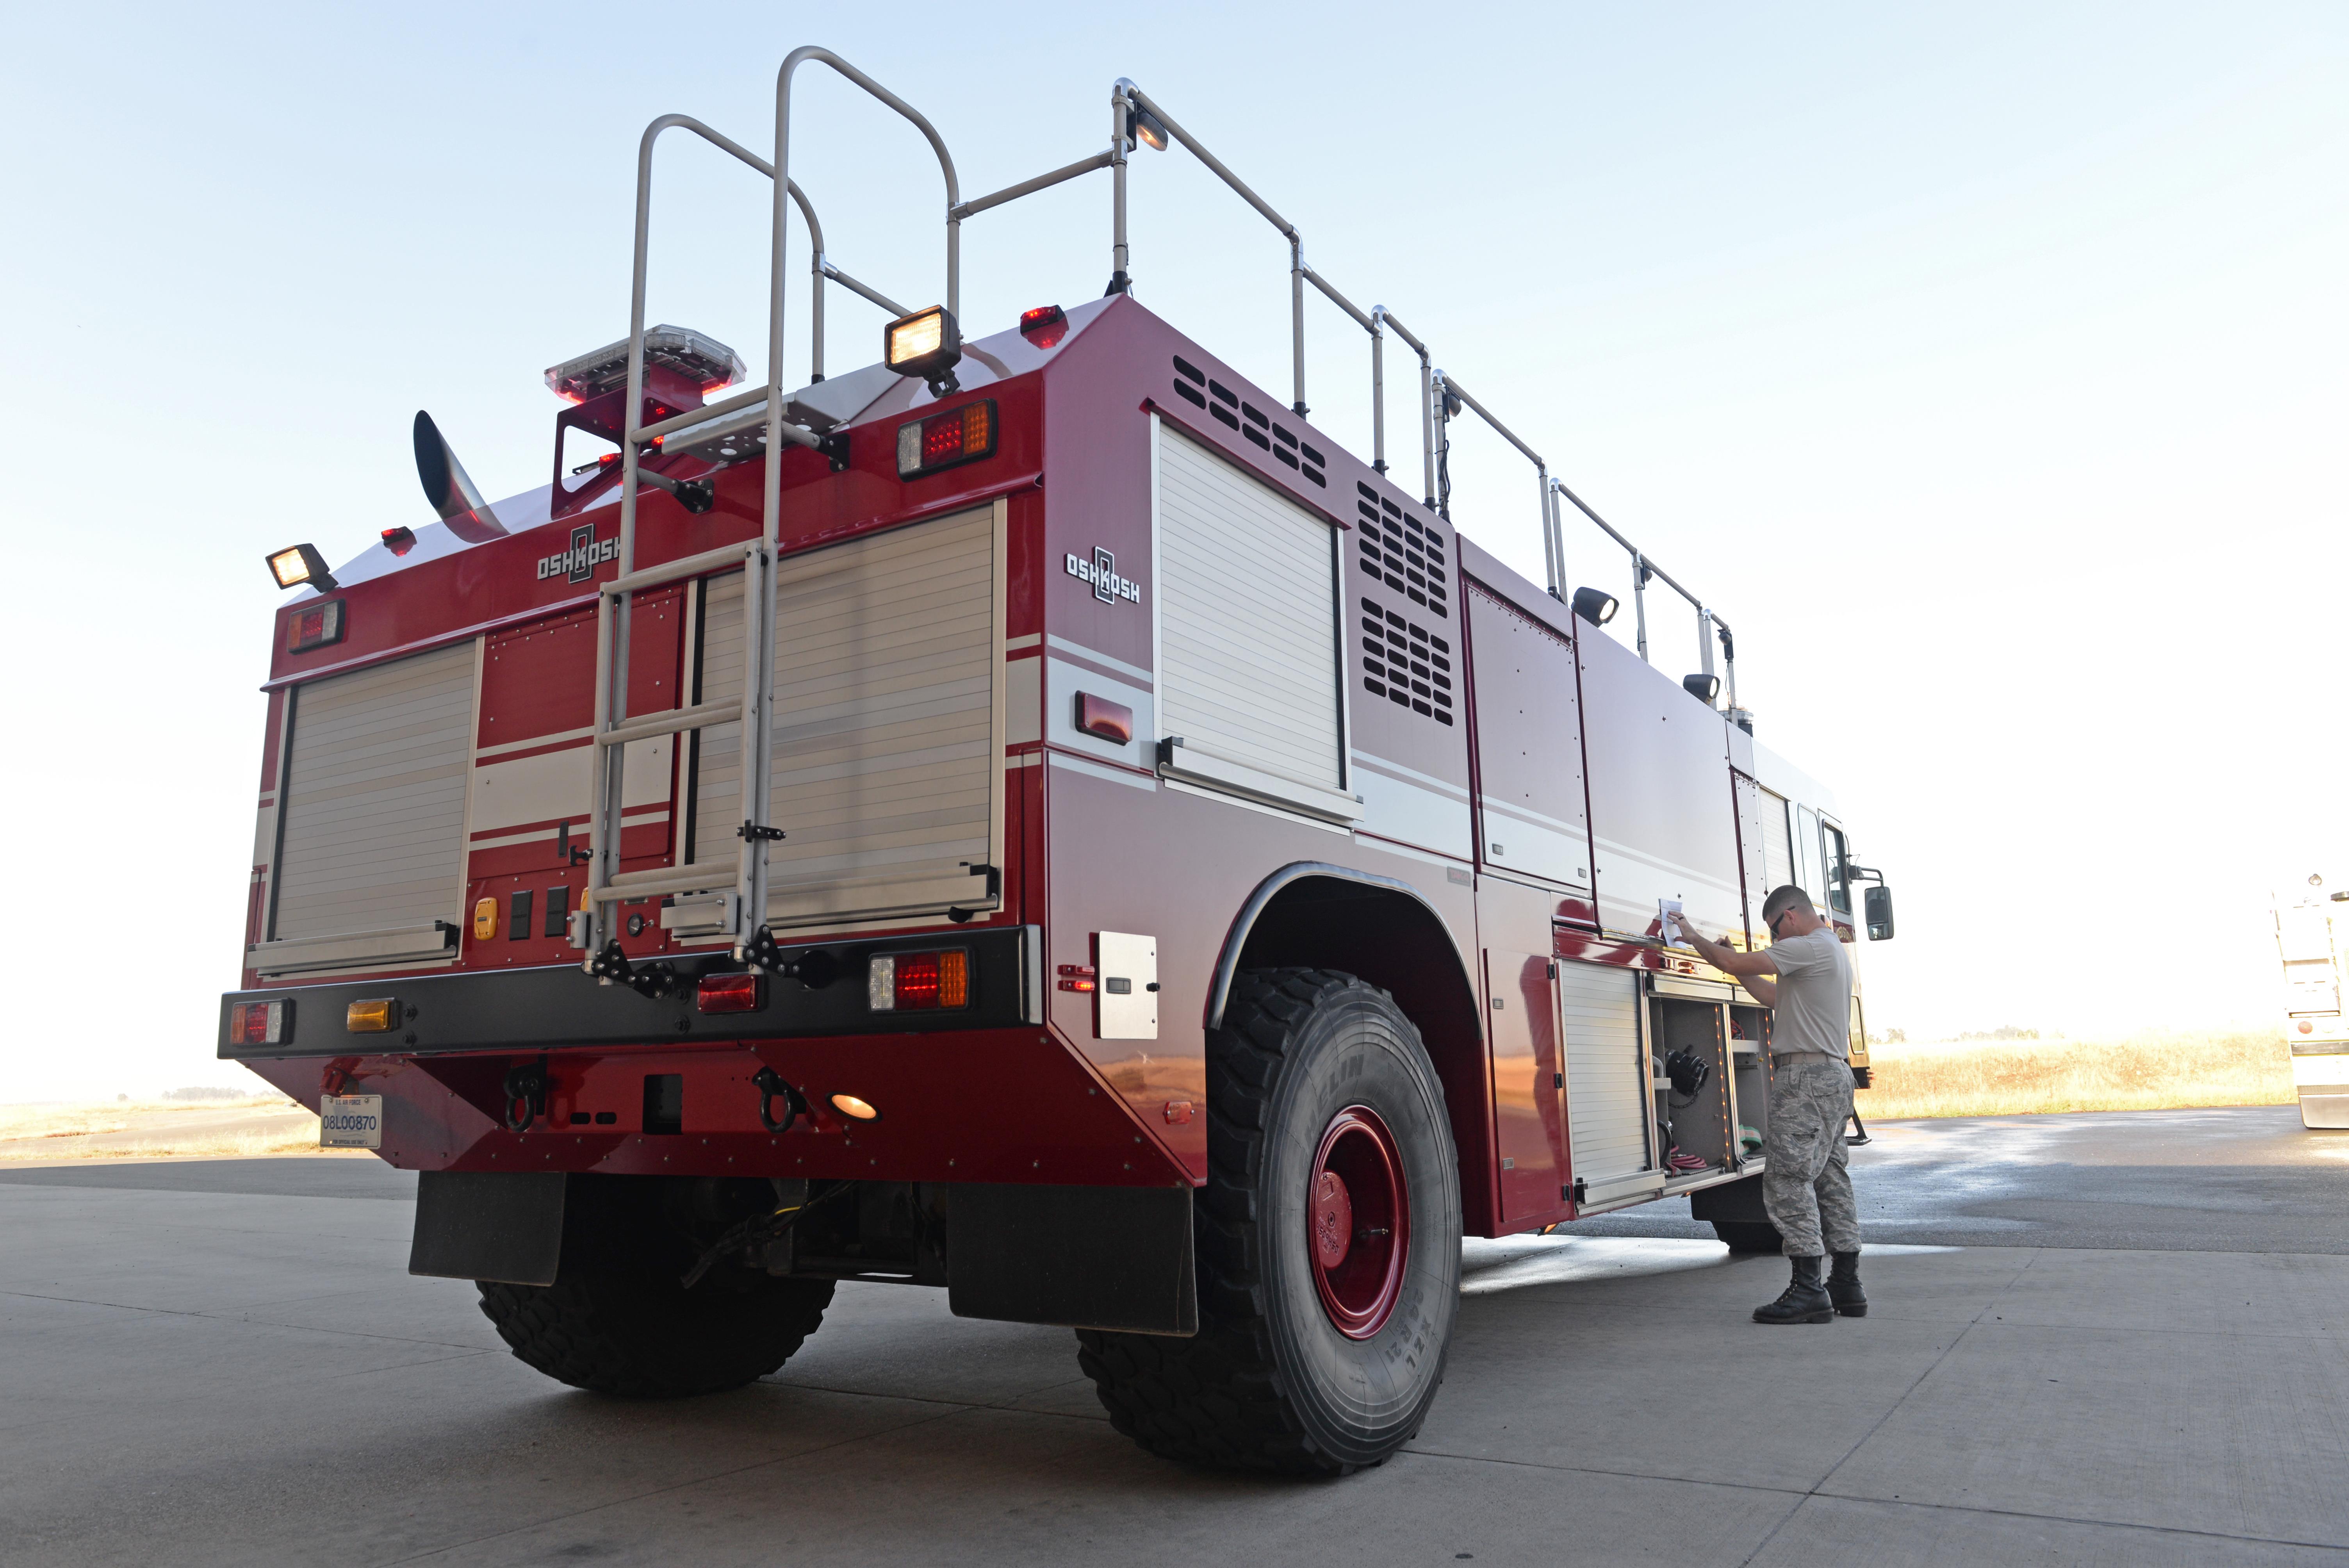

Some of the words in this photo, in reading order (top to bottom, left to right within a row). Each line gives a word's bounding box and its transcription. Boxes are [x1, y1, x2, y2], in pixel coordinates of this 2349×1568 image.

[1067, 553, 1139, 604] OSHKOSH
[323, 1115, 377, 1130] 08L00870
[1407, 1287, 1424, 1322] 24
[1400, 1324, 1413, 1344] R
[1406, 1314, 1431, 1368] XZL
[1385, 1341, 1402, 1364] 21
